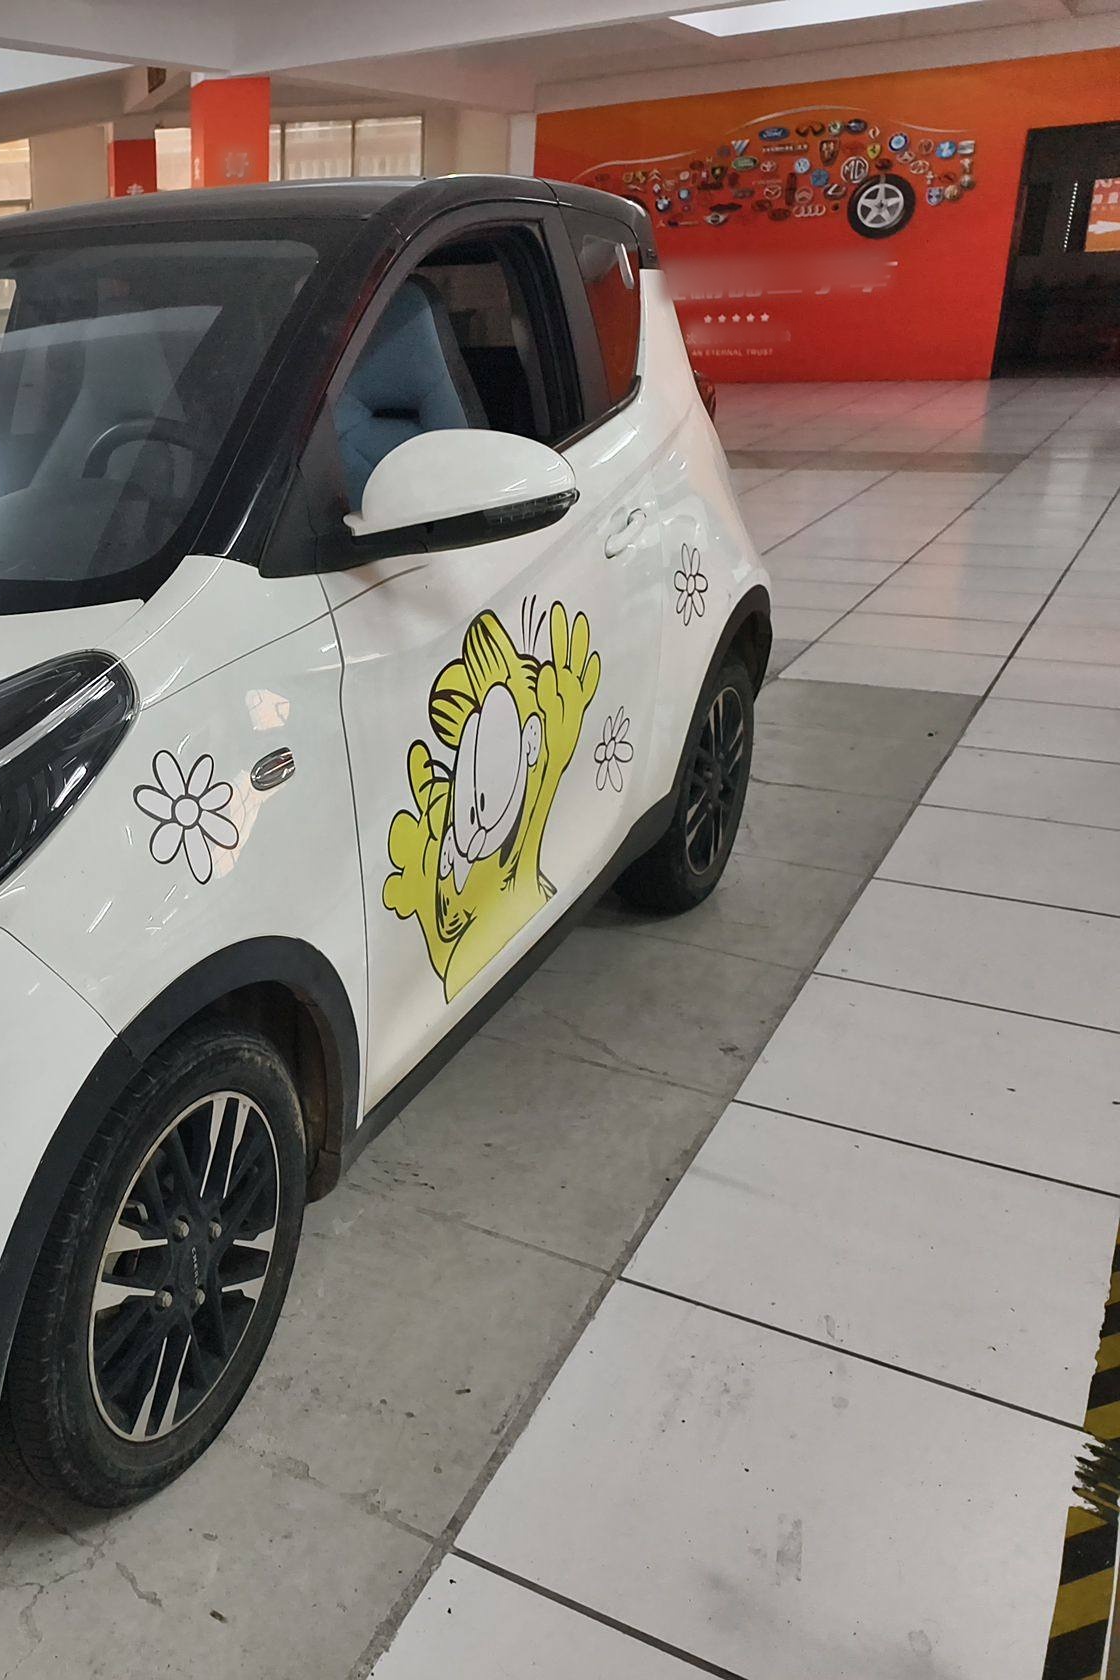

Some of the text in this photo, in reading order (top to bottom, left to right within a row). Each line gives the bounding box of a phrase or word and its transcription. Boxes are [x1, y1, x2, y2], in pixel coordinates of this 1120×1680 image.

[842, 157, 868, 182] MG
[706, 348, 742, 356] ETERNAL
[746, 348, 773, 356] TRUST
